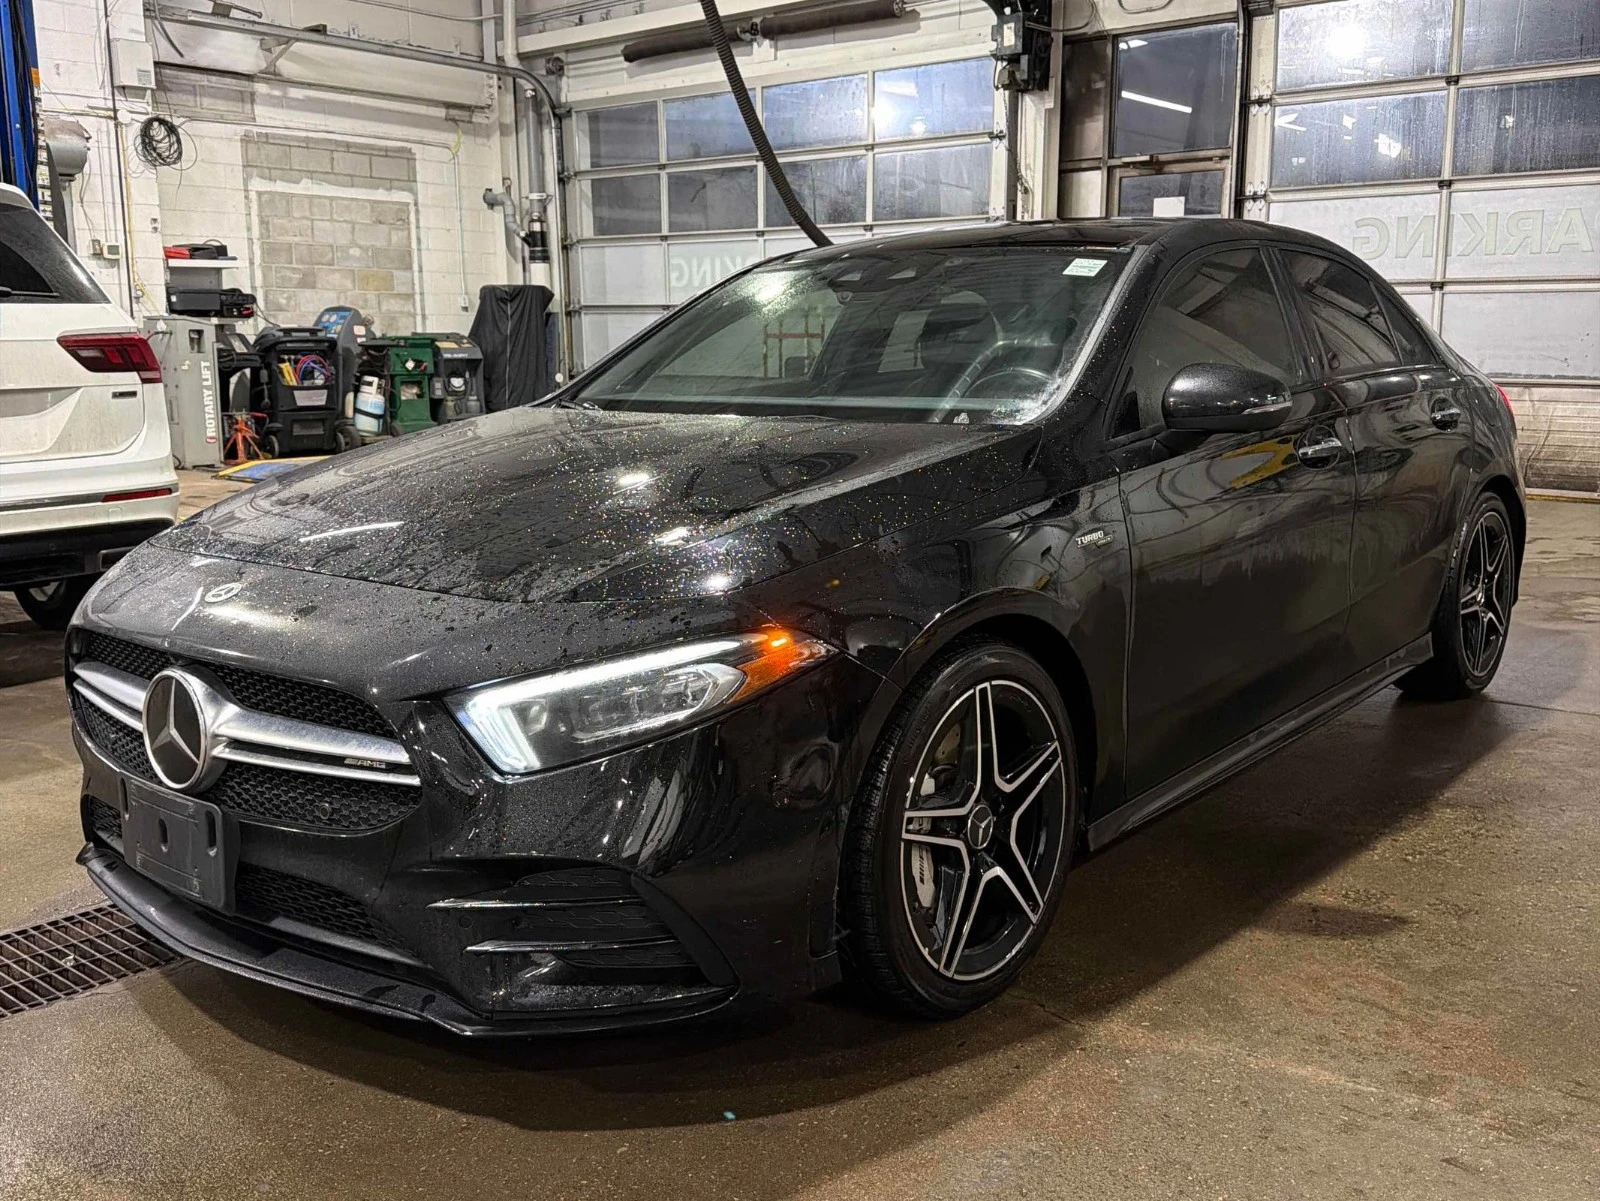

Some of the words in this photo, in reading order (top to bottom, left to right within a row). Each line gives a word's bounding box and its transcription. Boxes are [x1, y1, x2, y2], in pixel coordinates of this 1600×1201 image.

[200, 360, 212, 386] LIFT
[203, 388, 217, 437] ROTARY
[1075, 530, 1104, 545] TURBO
[357, 760, 386, 769] AMG
